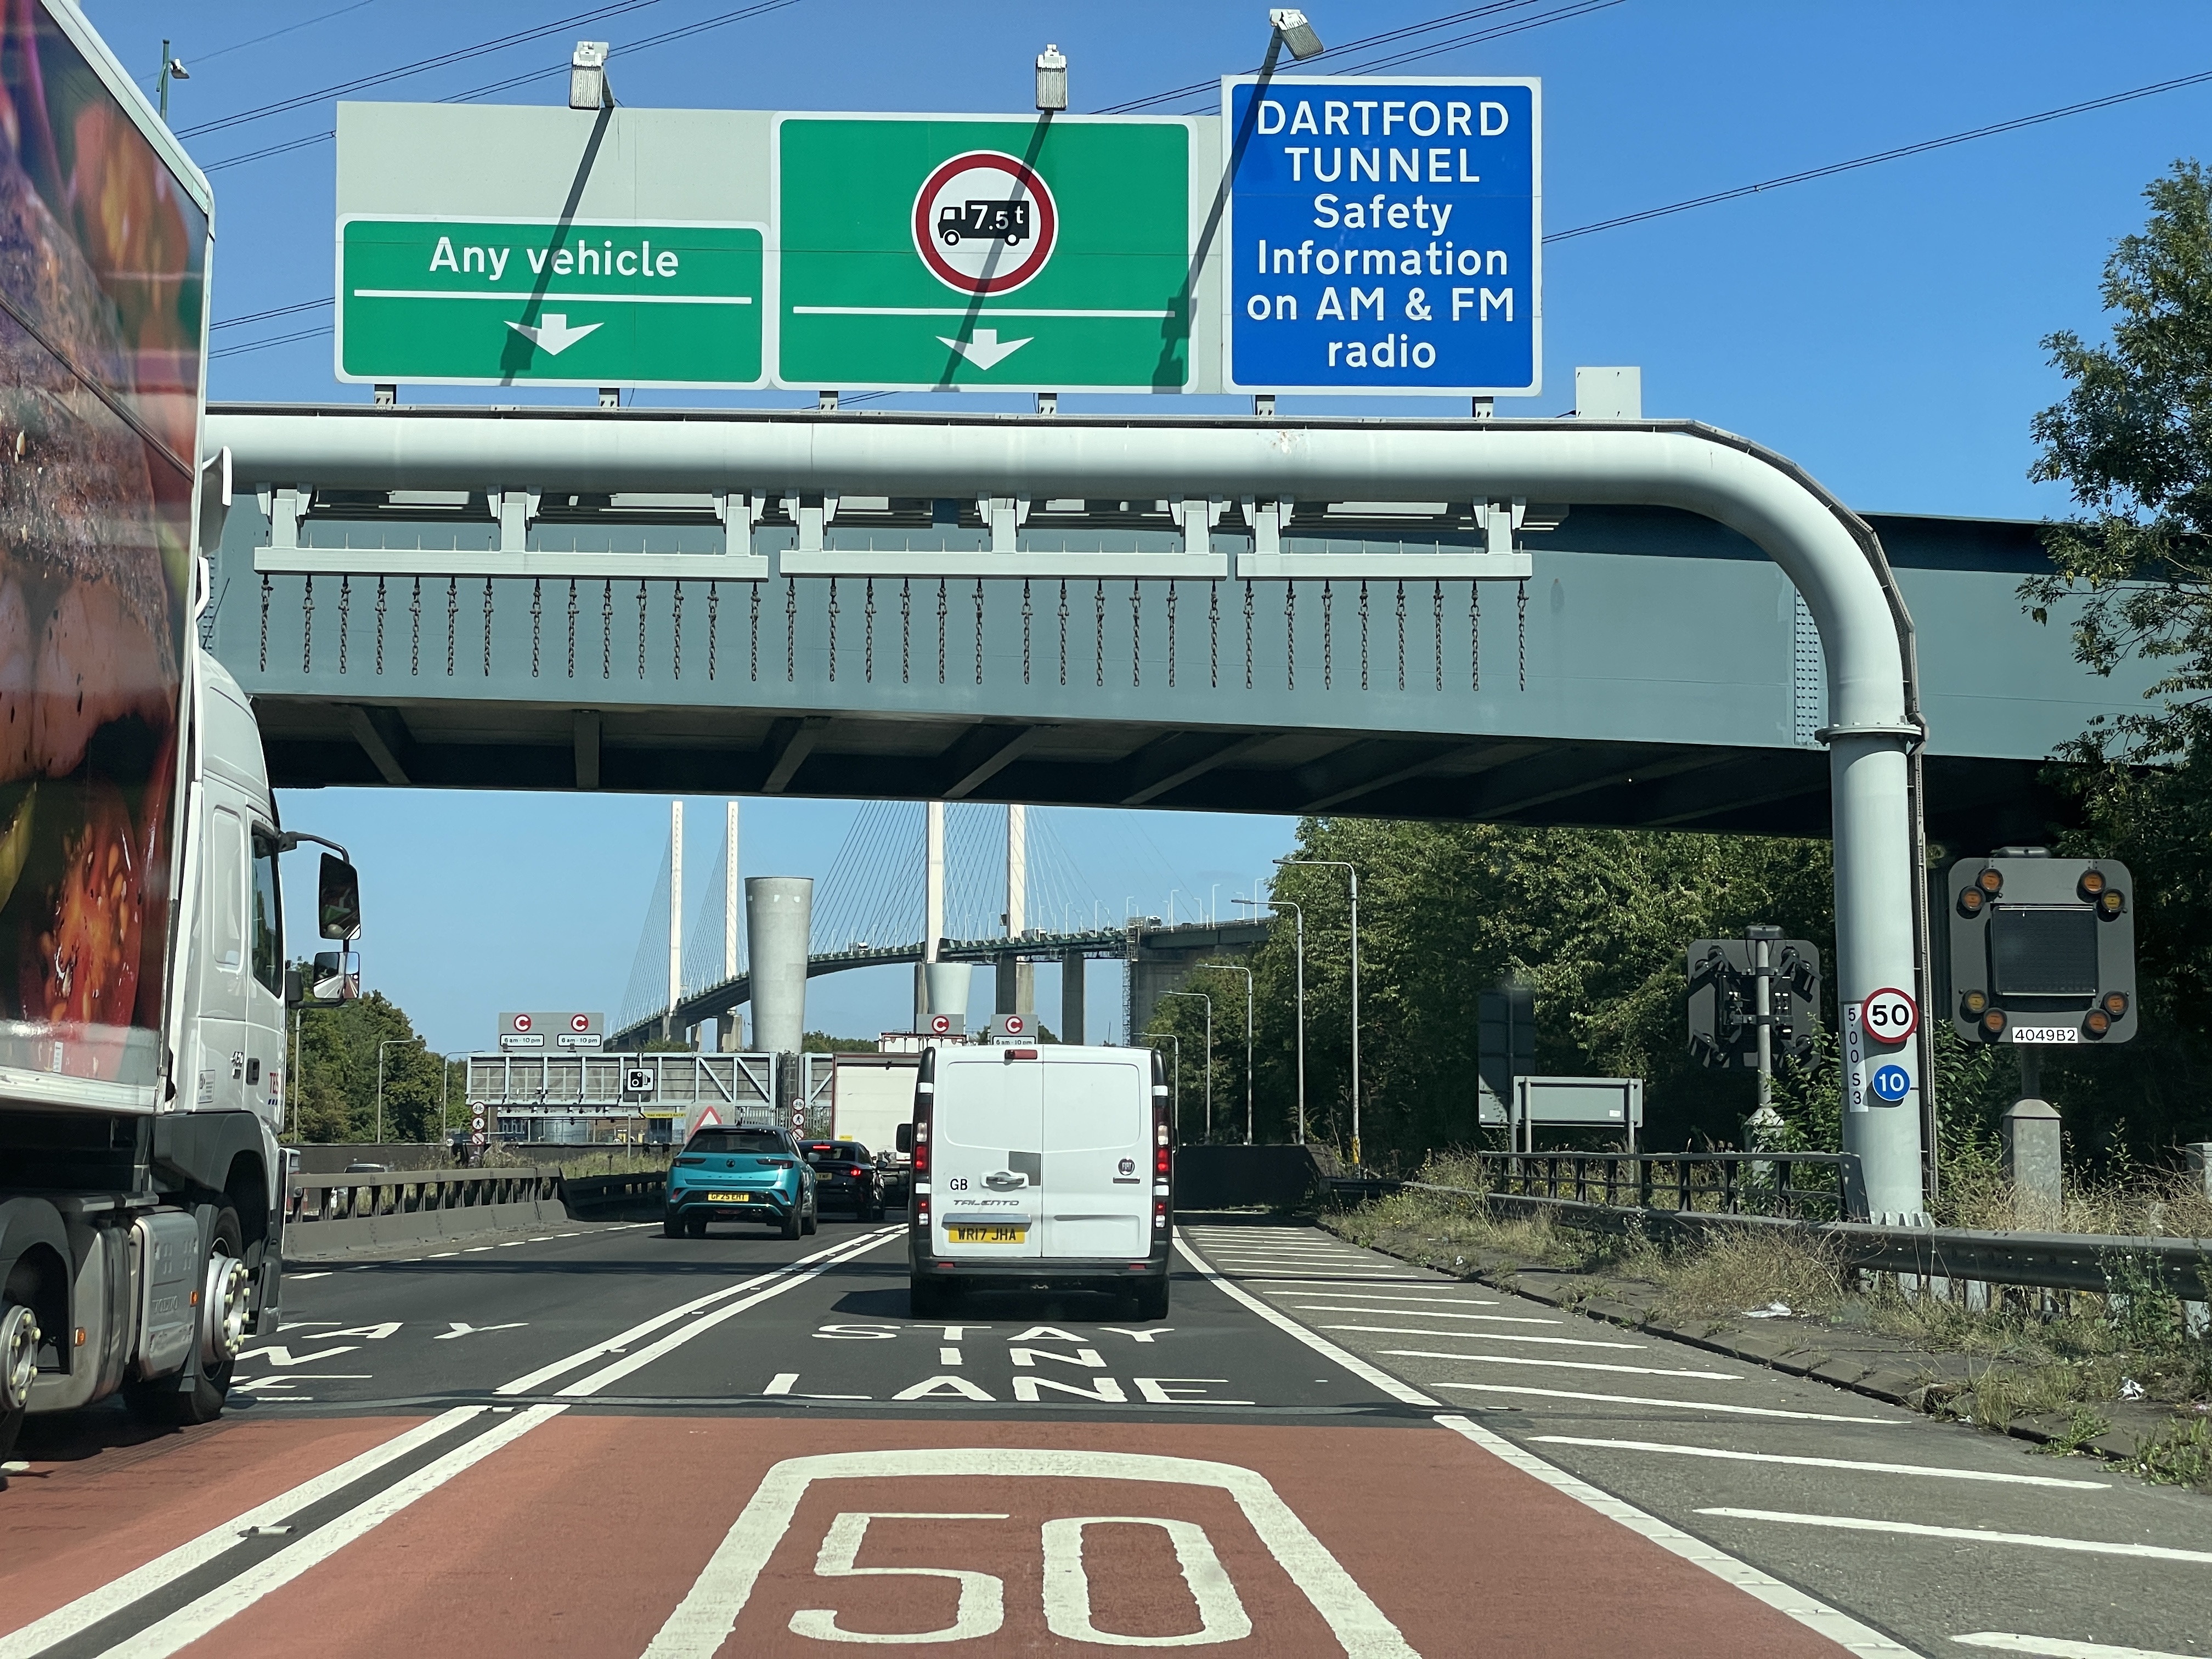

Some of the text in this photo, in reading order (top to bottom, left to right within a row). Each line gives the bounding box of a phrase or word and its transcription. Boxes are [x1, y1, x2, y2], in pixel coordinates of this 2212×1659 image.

[1257, 100, 1509, 136] DARTFORD
[1285, 147, 1480, 182] TUNNEL
[1313, 193, 1453, 236] Safety
[429, 236, 679, 281] Any vehicle
[1259, 239, 1508, 276] Information
[1247, 286, 1514, 321] on AM & FM
[1328, 334, 1436, 368] radio
[1872, 1004, 1909, 1026] 50
[2015, 1029, 2075, 1041] 4049B2
[1879, 1073, 1904, 1092] 10
[950, 1178, 968, 1190] GB
[958, 1228, 1016, 1240] WR17 JHA
[812, 1324, 1175, 1342] STAY
[939, 1347, 1107, 1368] IN
[763, 1373, 1256, 1405] LANE
[788, 1512, 1252, 1646] 50
